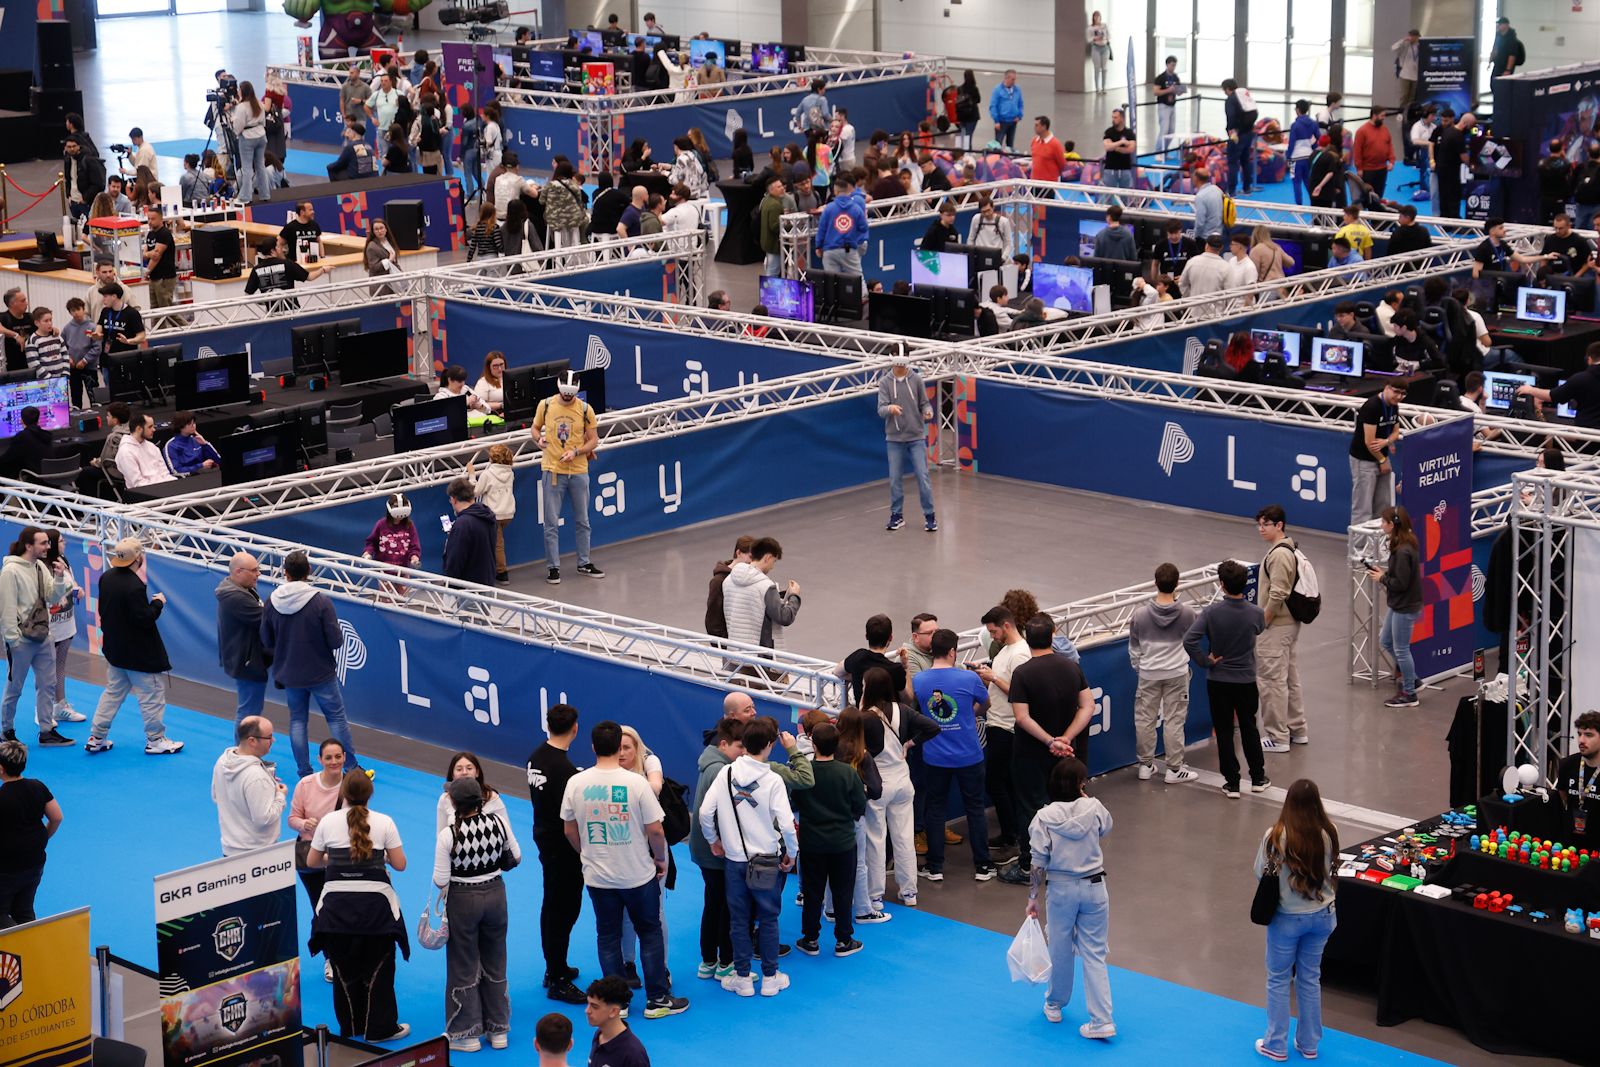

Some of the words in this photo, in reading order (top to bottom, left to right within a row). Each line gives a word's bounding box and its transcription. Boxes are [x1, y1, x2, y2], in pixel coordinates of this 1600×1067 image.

[312, 106, 343, 124] PLa
[724, 104, 838, 142] PLa
[1158, 421, 1395, 508] PLa
[1418, 452, 1461, 474] VIRTUAL
[1418, 466, 1461, 488] REALITY
[537, 460, 682, 527] Lay
[160, 885, 192, 904] GKR
[197, 873, 247, 894] Gaming
[251, 860, 292, 879] Group
[22, 997, 76, 1024] CÓRDOBA
[6, 1033, 18, 1046] DE
[20, 1017, 76, 1041] ESTUDIANTES
